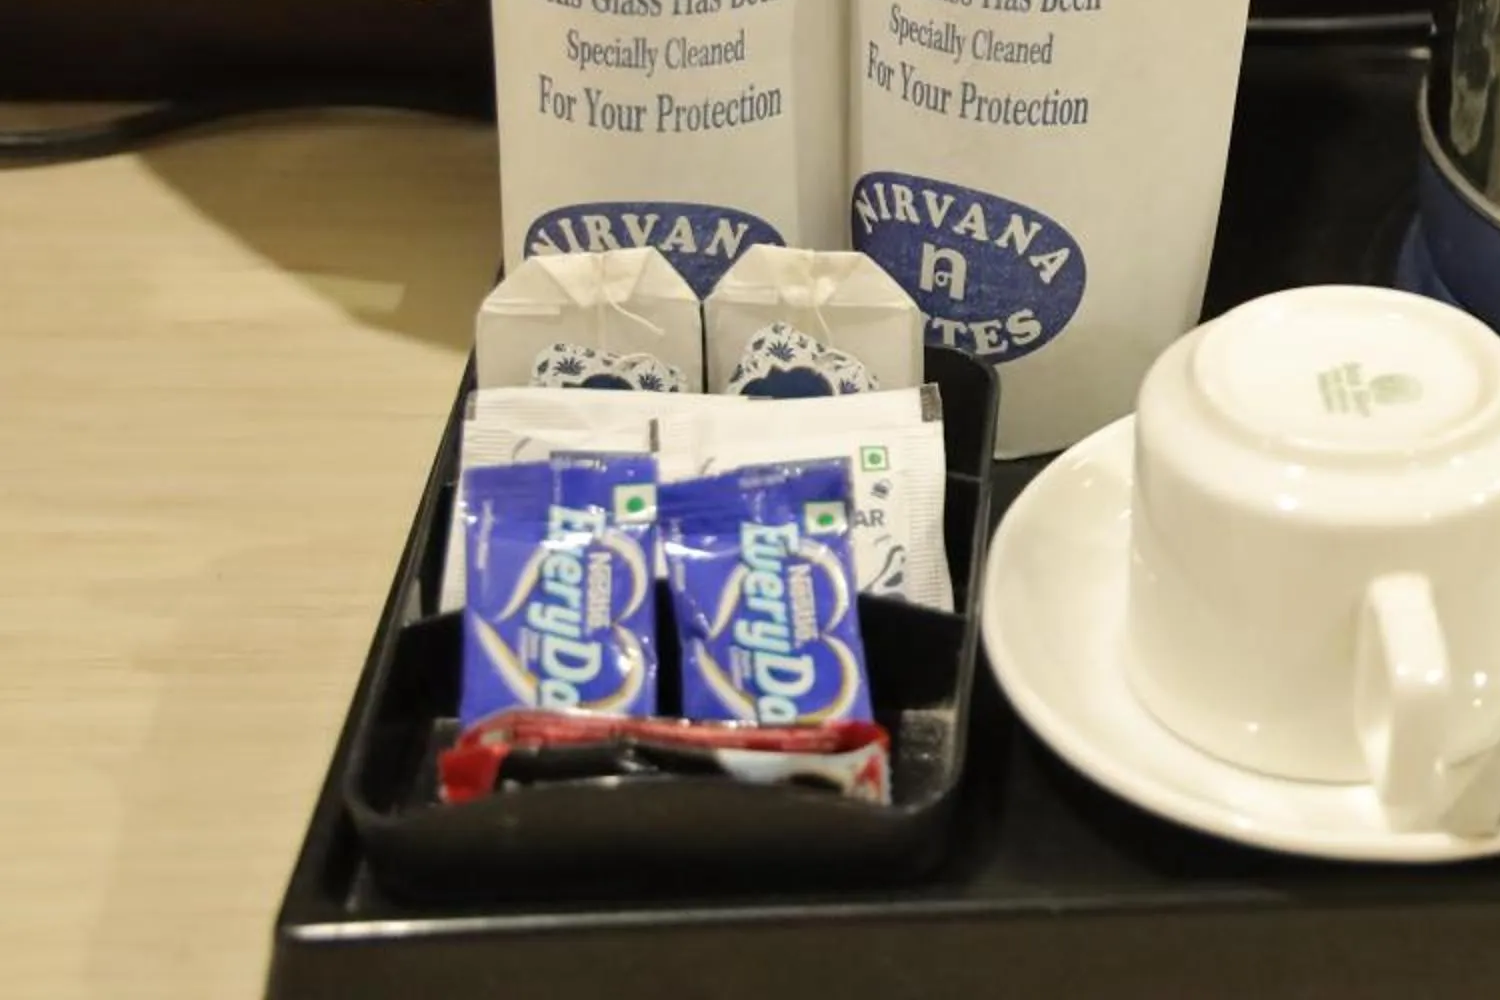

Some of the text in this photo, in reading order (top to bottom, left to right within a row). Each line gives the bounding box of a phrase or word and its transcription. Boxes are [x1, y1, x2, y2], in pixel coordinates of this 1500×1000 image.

[566, 28, 745, 78] Specially Cleaned
[890, 4, 1054, 65] Specially Cleaned
[539, 74, 782, 133] For Your Protection
[867, 41, 1089, 126] For Your Protection
[531, 214, 752, 258] NIRVAN
[855, 182, 1070, 284] NIRVANA
